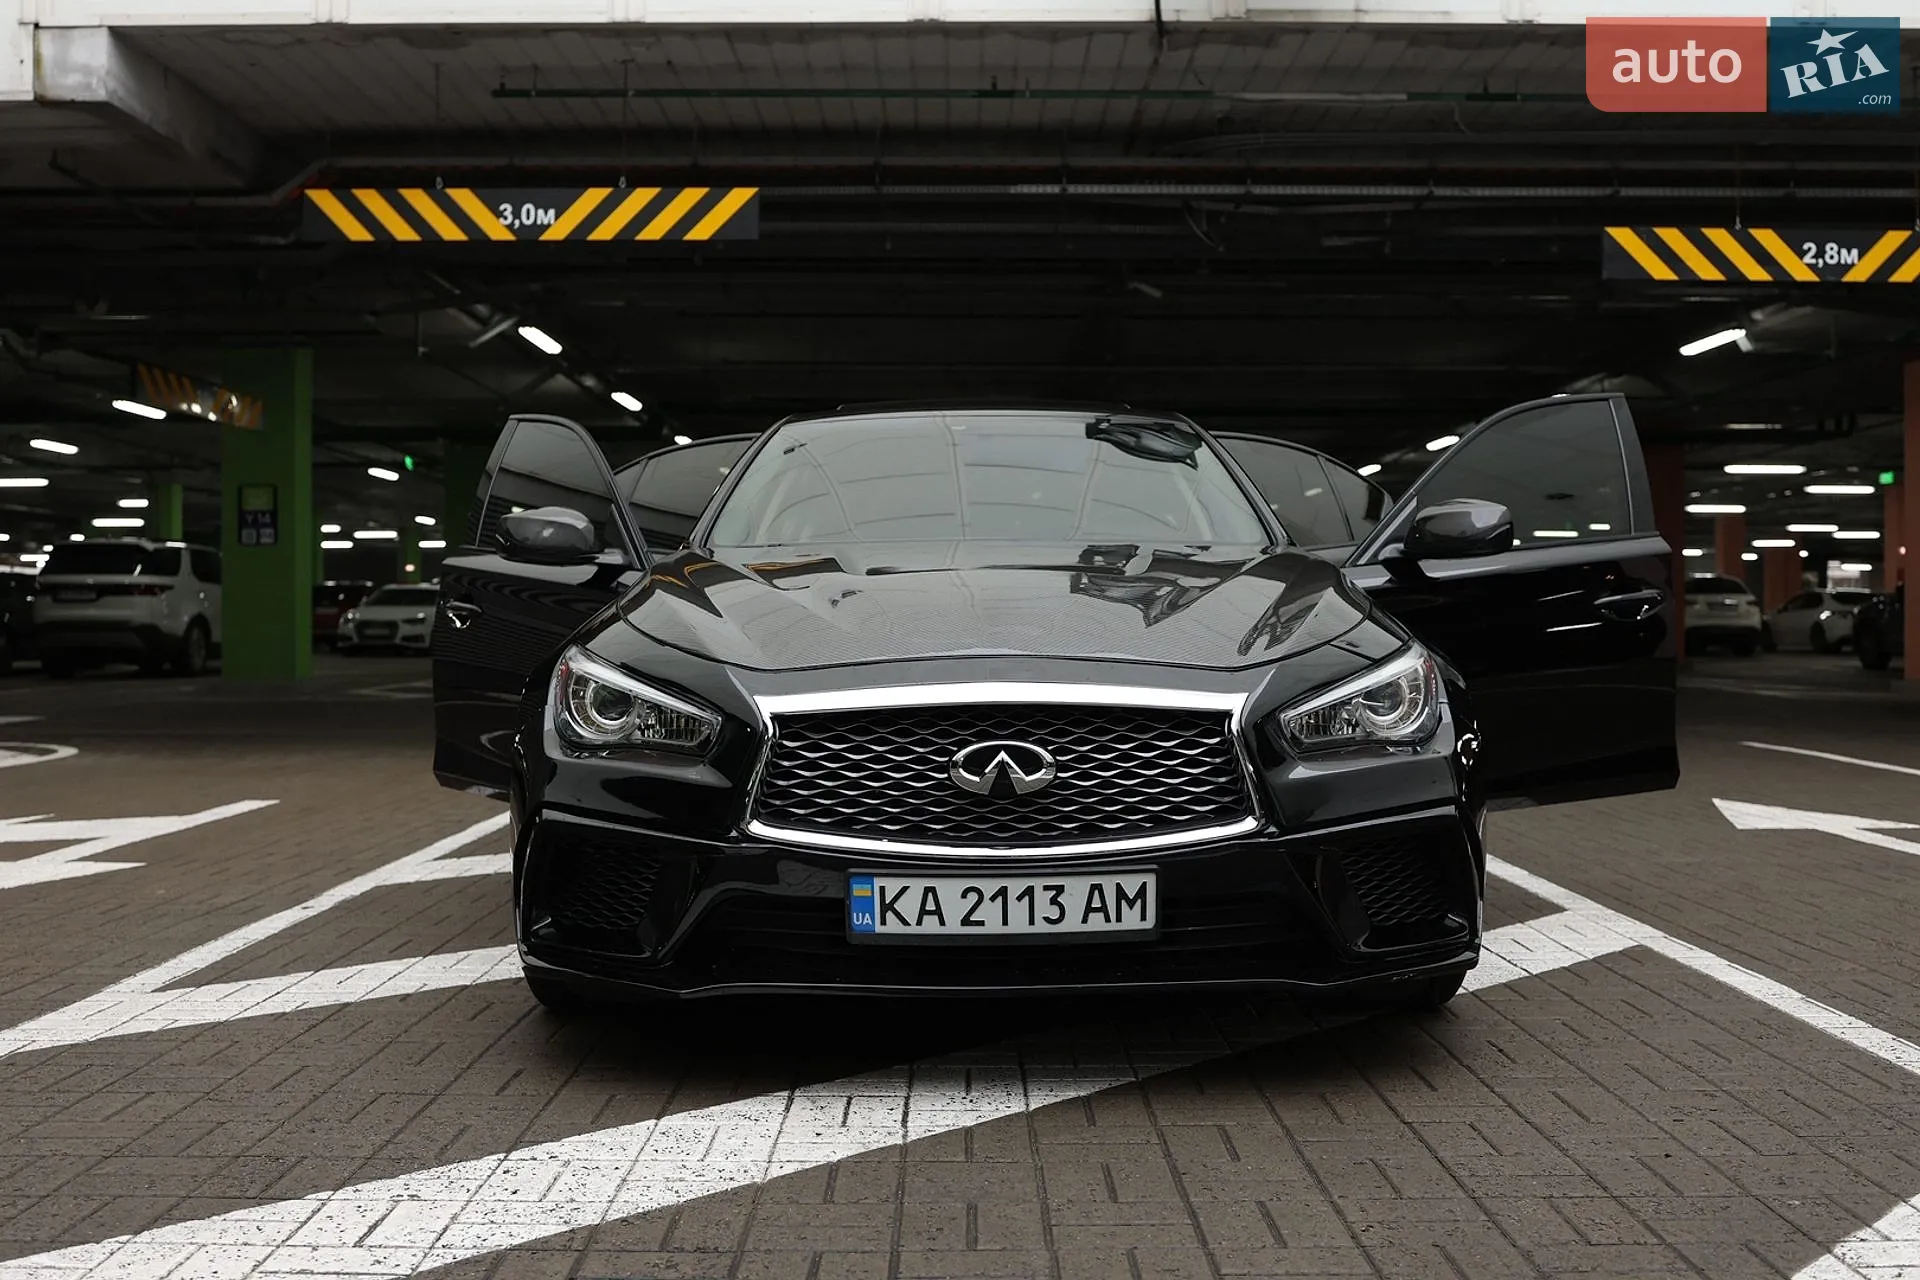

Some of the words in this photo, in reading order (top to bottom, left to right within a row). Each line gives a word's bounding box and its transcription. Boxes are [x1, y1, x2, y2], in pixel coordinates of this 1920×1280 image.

[853, 912, 873, 925] UA
[879, 884, 946, 927] KA
[960, 884, 1066, 927] 2113
[1081, 881, 1148, 924] AM
